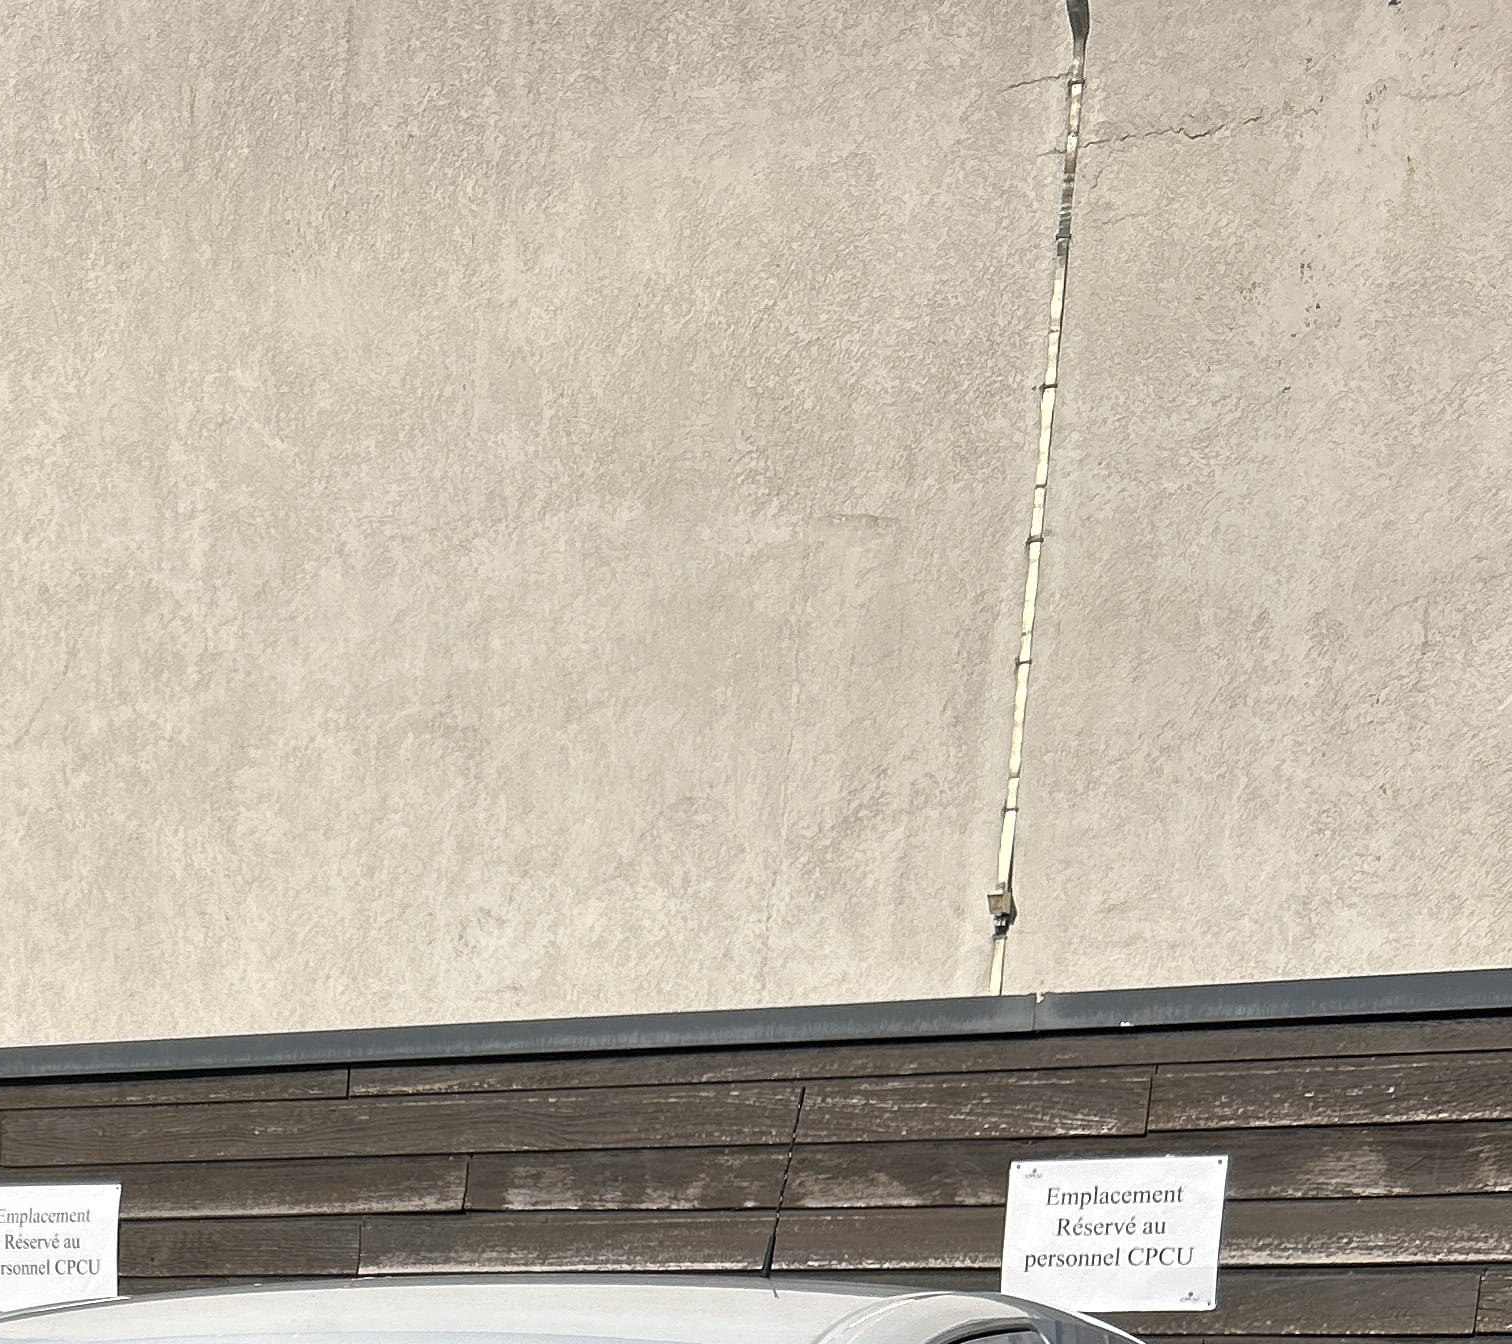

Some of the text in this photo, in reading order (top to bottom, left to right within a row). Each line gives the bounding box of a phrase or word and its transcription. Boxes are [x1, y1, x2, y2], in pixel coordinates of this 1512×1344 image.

[1046, 1185, 1185, 1210] Emplacement
[1055, 1216, 1167, 1237] Réservé au
[5, 1233, 81, 1250] Réservé au
[54, 1259, 101, 1276] CPCU
[1024, 1247, 1194, 1272] personnel CPCU
